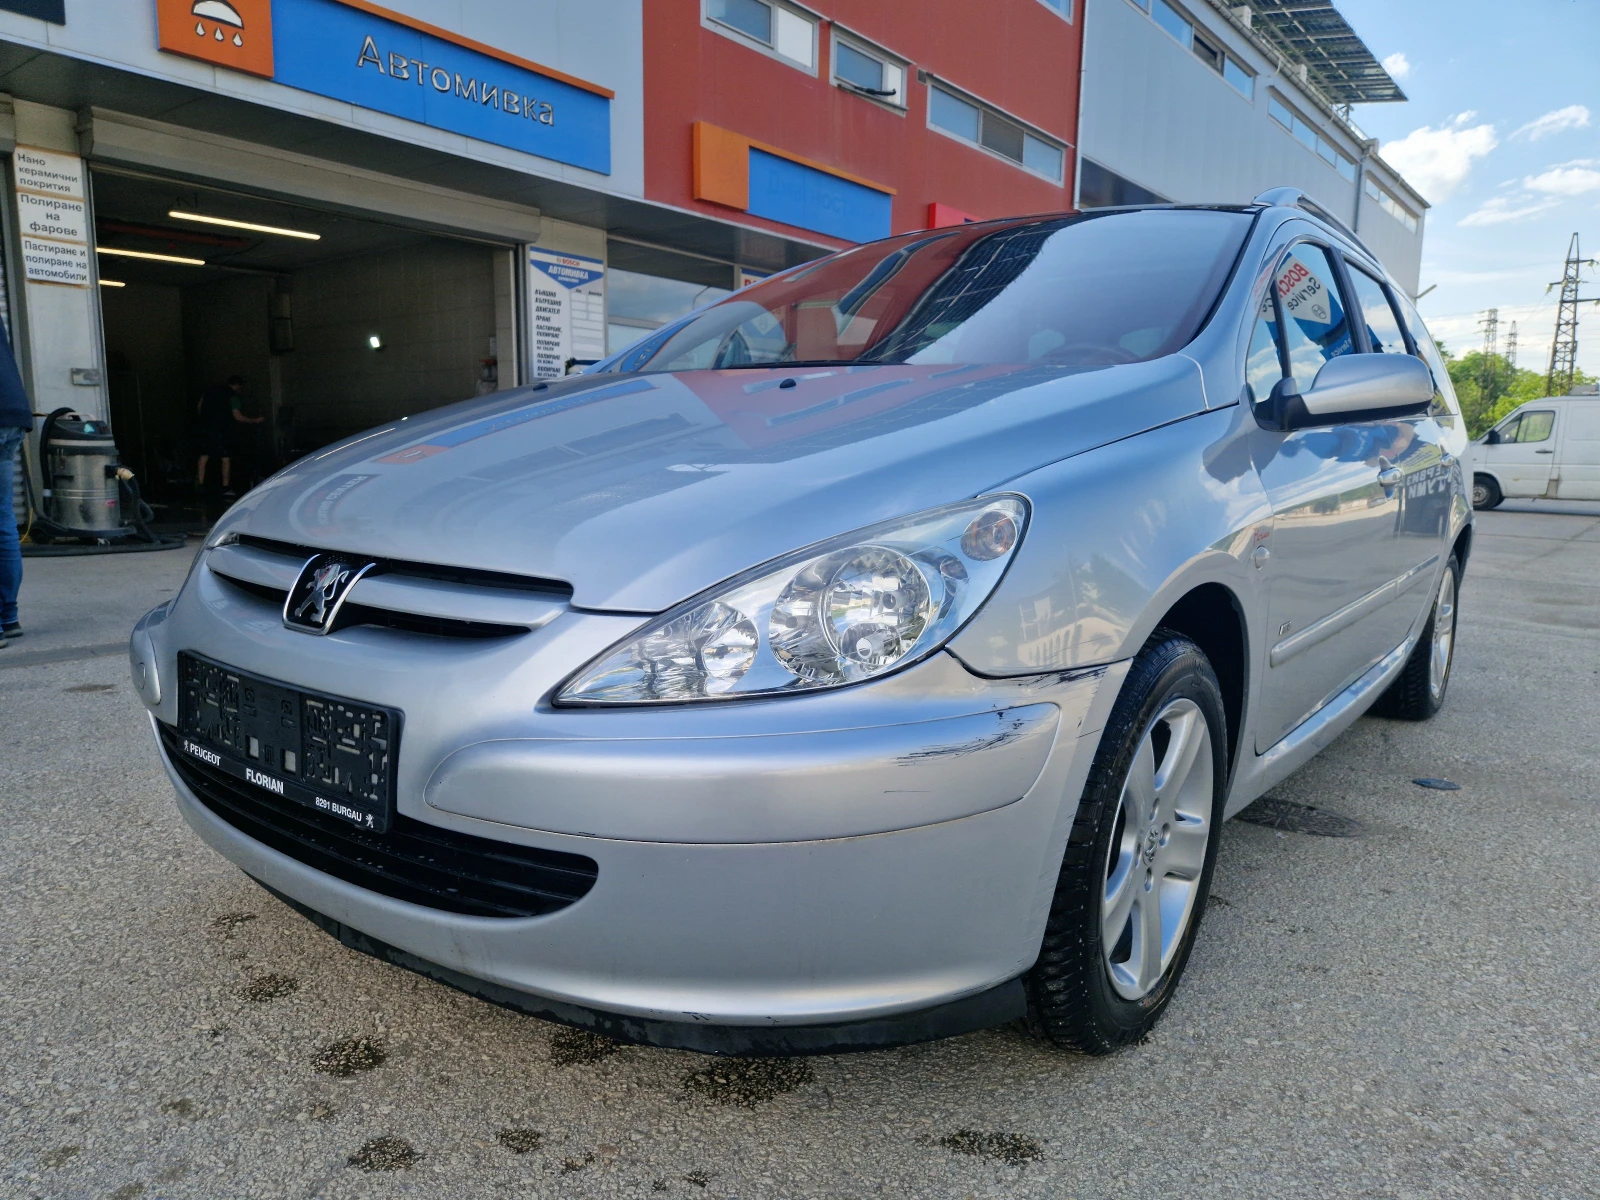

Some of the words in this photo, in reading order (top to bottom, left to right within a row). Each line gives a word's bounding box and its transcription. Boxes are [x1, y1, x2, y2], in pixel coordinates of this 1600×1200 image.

[357, 35, 554, 126] Автомивка
[17, 153, 46, 166] Нано
[19, 166, 78, 183] керамични
[20, 178, 71, 193] покрития
[20, 194, 82, 212] Полиране
[46, 212, 60, 221] на
[30, 221, 78, 236] фарове
[25, 240, 77, 256] Пастиране
[80, 249, 86, 257] и
[25, 255, 73, 267] полиране
[76, 261, 87, 269] на
[28, 267, 87, 281] автомобили
[548, 265, 589, 280] АВТОМИВКА
[189, 742, 221, 767] PEUGEOT
[245, 767, 284, 794] FLORIAN
[315, 796, 331, 810] 8291
[331, 802, 362, 823] BURGAU
